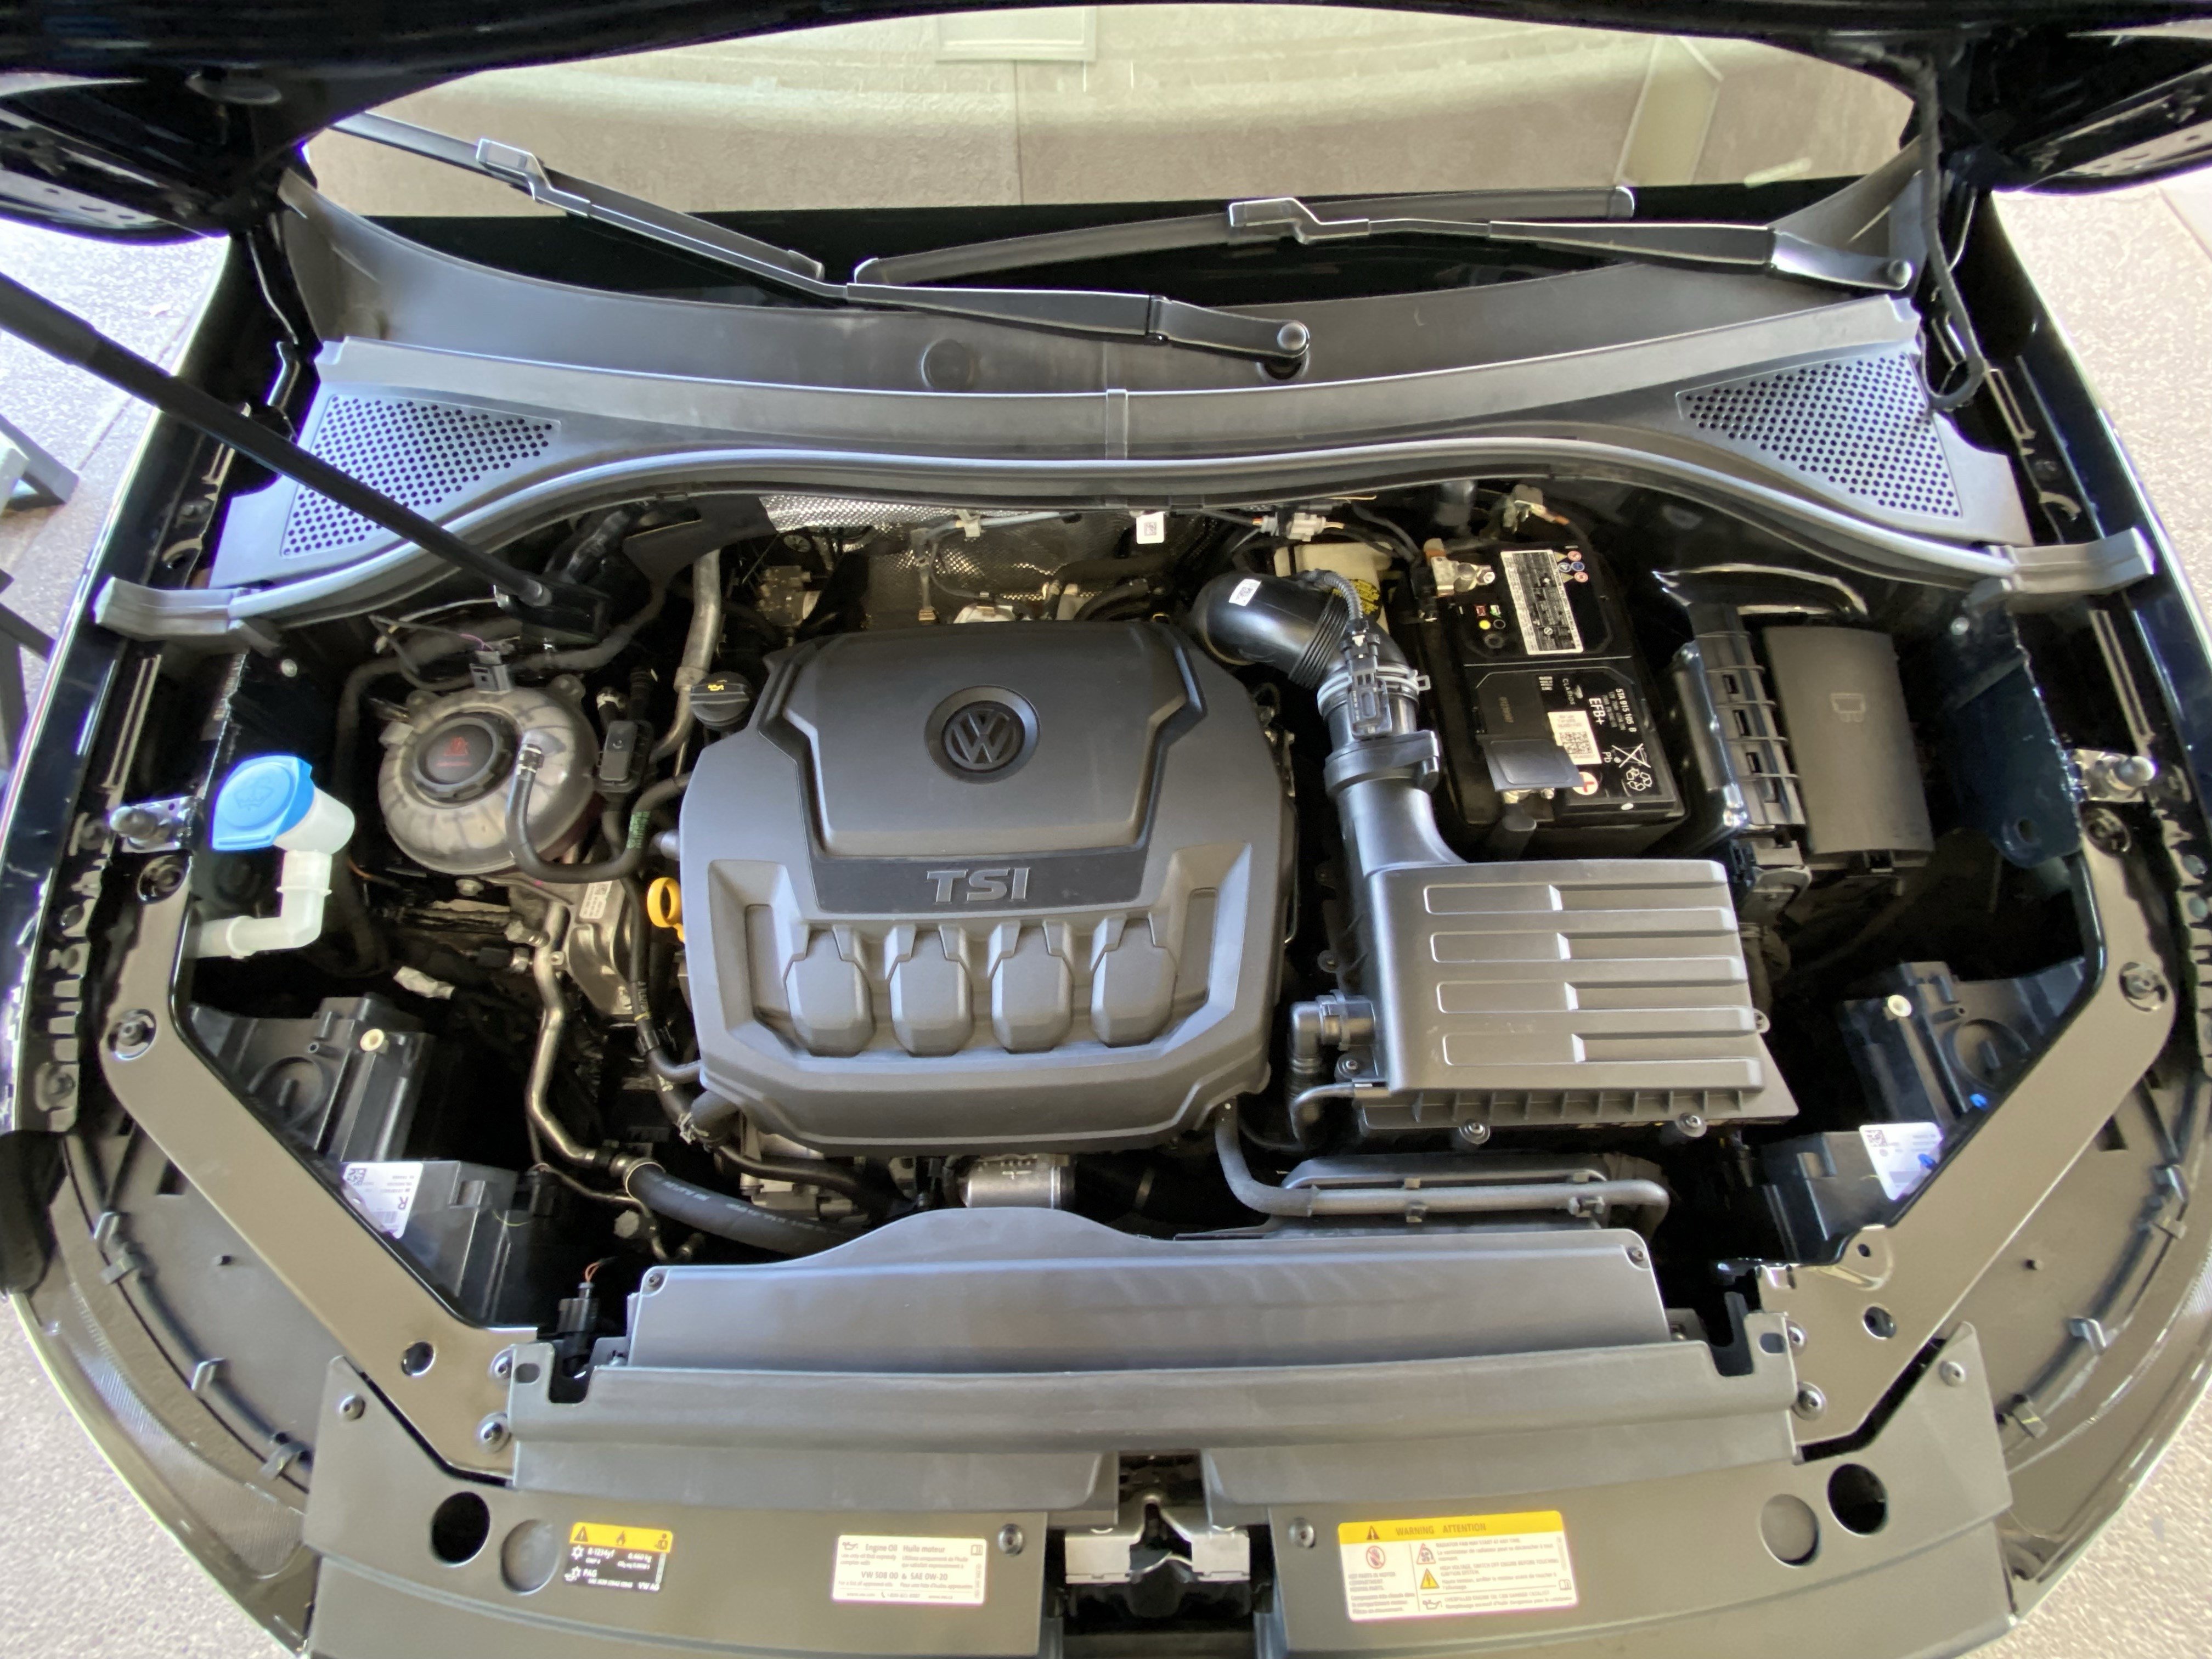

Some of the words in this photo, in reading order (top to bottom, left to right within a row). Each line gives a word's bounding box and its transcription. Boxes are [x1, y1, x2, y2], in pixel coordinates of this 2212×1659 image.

[1589, 698, 1606, 725] EFB+
[1602, 752, 1613, 763] Pb
[927, 867, 1030, 903] TSI
[397, 1197, 409, 1210] R
[1396, 1526, 1434, 1536] WARNING
[1443, 1523, 1486, 1533] ATTENTION
[865, 1543, 887, 1553] Engine
[583, 1568, 597, 1577] PAG
[910, 1572, 922, 1580] SAE
[924, 1572, 947, 1581] 0W-20
[639, 1582, 650, 1590] VW
